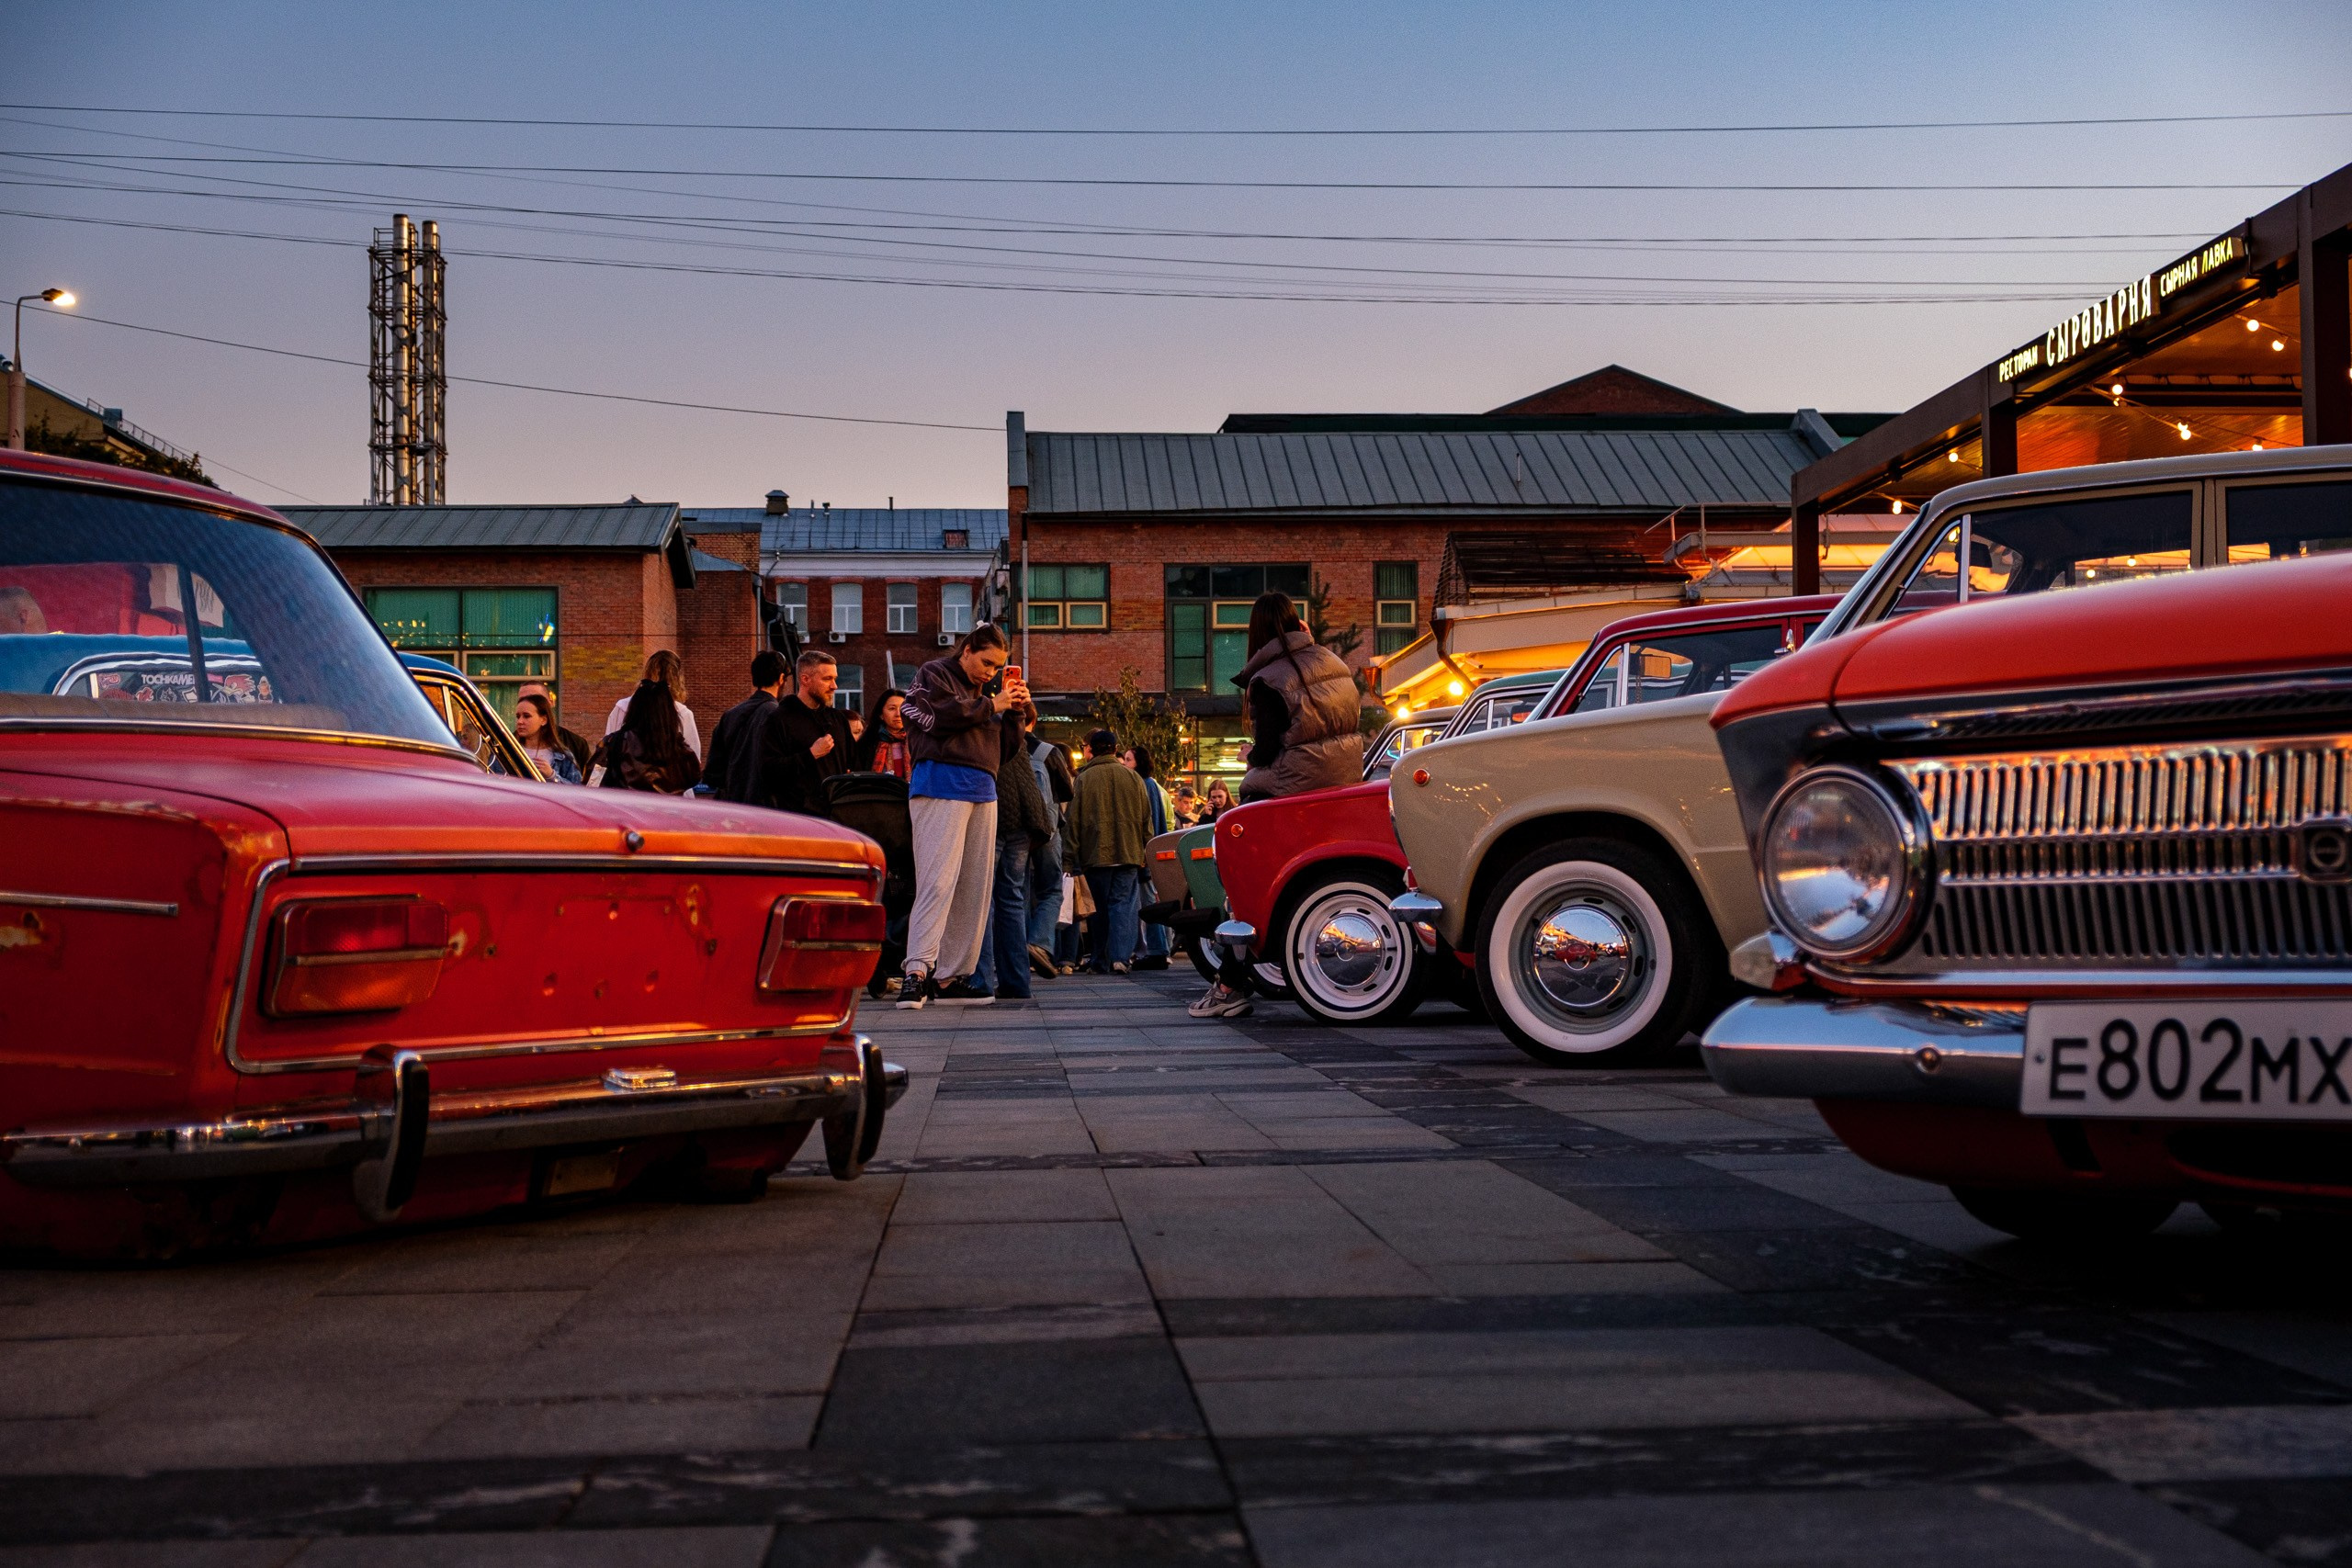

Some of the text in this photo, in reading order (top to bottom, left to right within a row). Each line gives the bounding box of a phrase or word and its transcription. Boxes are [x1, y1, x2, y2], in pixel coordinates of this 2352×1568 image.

[1998, 236, 2233, 383] РЕСТОРАН СЫРОВАРНЯ СЫРНАЯ ЛАВКА
